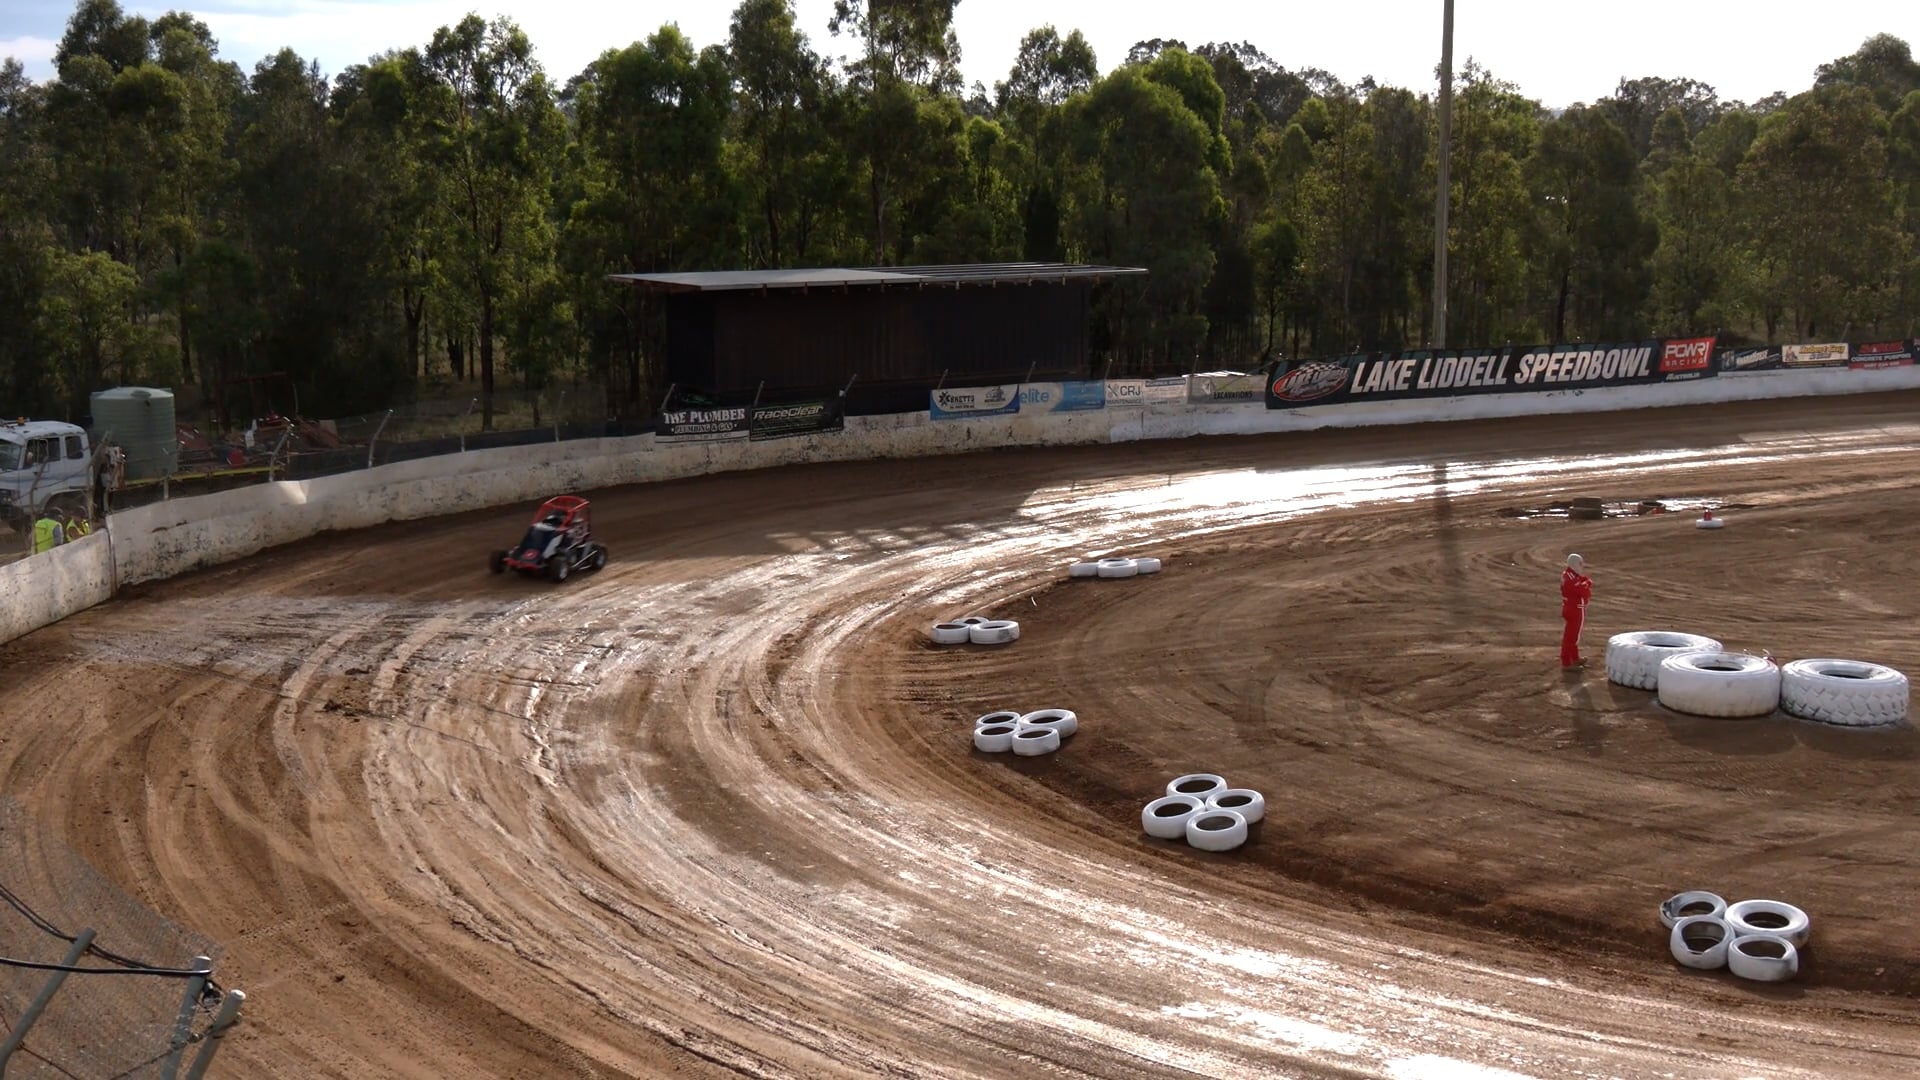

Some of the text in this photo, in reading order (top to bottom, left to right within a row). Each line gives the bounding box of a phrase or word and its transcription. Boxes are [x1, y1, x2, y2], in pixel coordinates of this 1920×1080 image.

[1665, 358, 1703, 367] RACING
[1350, 359, 1416, 394] LAKE
[1417, 354, 1507, 390] LIDDELL
[1514, 347, 1652, 385] SPEEDBOWL
[1019, 388, 1050, 404] elite
[1120, 385, 1141, 396] CRJ
[1213, 391, 1253, 400] EXCAVATIONS
[663, 408, 745, 425] THE PLUMBER
[753, 405, 824, 420] RaceClear
